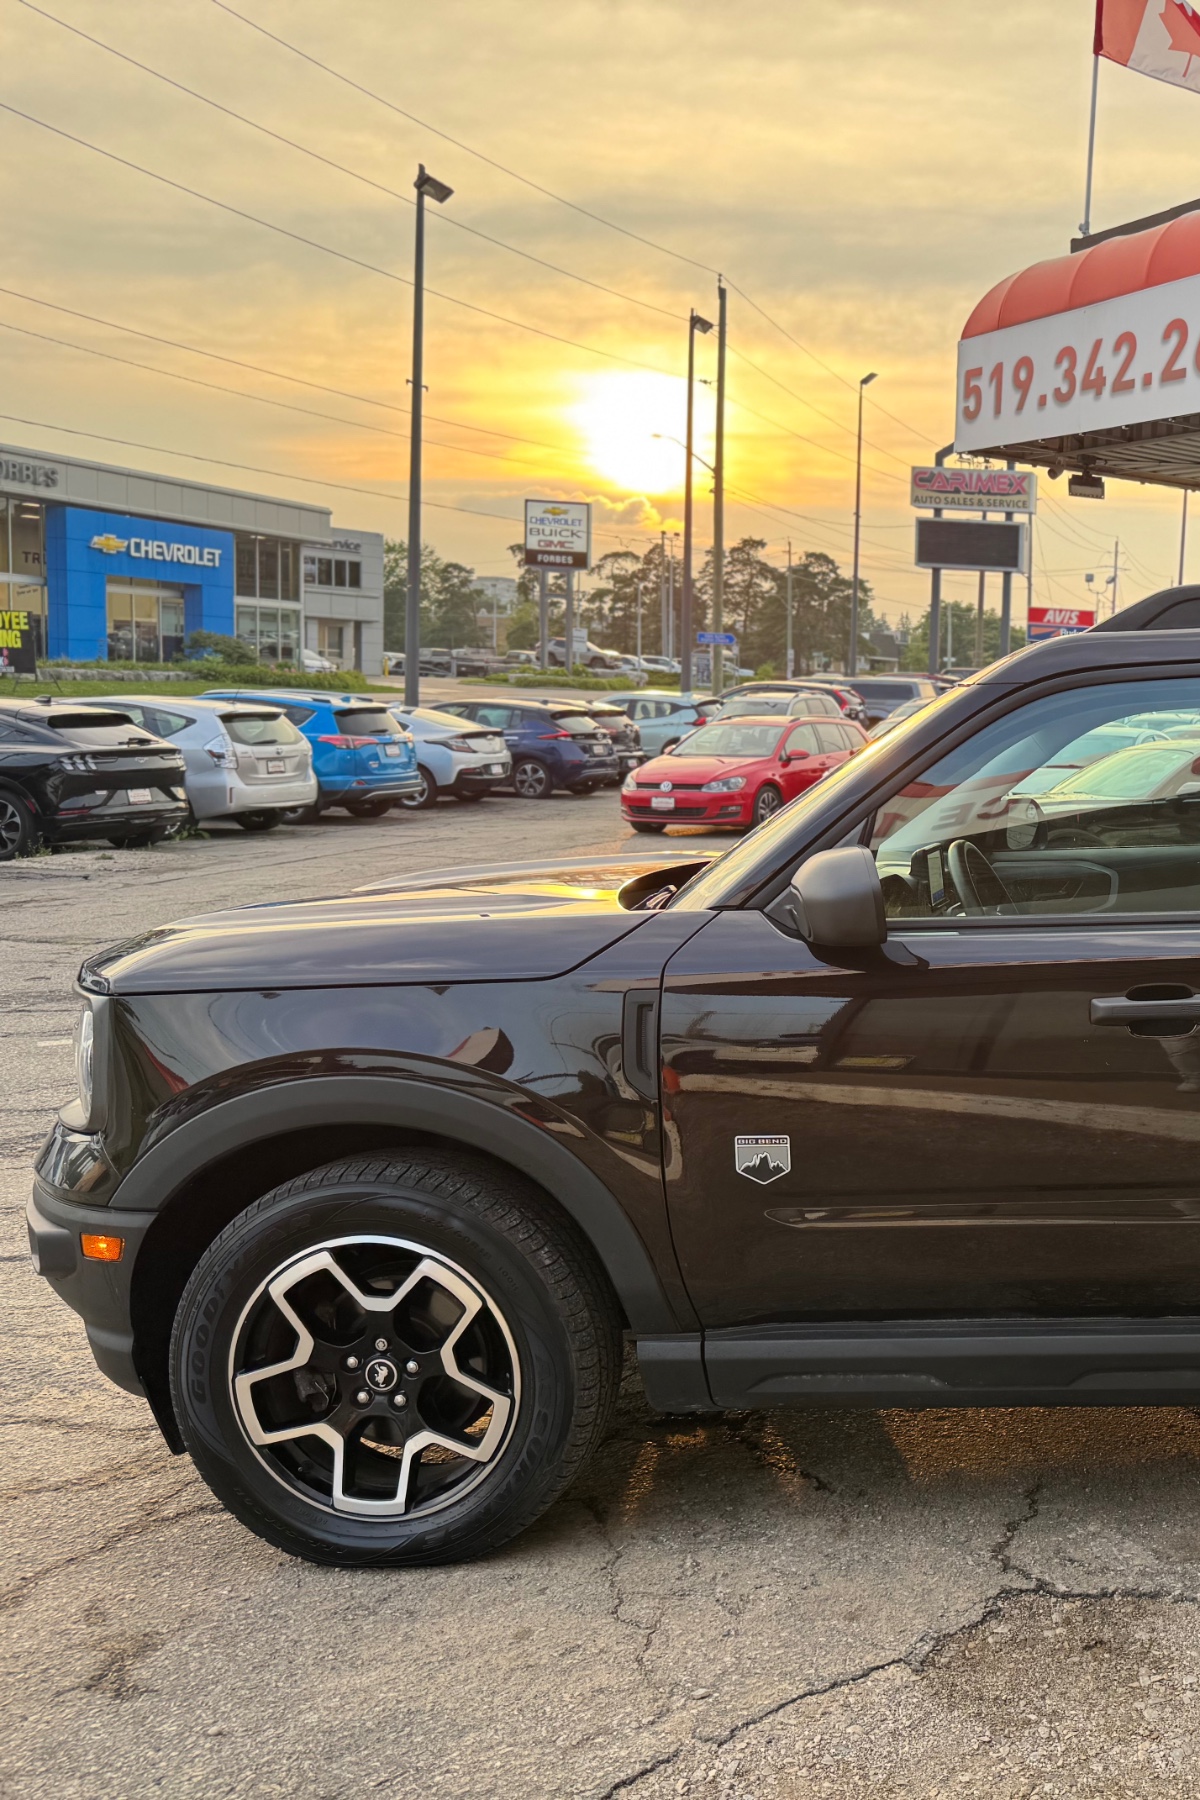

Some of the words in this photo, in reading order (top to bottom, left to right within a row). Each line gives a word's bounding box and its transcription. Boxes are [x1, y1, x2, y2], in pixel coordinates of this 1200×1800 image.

[913, 470, 1028, 495] CARIMEX
[914, 495, 942, 505] AUTO
[943, 496, 975, 507] SALES
[976, 499, 985, 507] &
[987, 499, 1028, 509] SERVICE
[529, 516, 583, 527] CHEVROLET
[528, 527, 583, 539] BUICK
[537, 539, 575, 549] GMC
[130, 538, 222, 568] CHEVROLET
[537, 554, 574, 565] FORBES
[1042, 609, 1080, 625] AVIS
